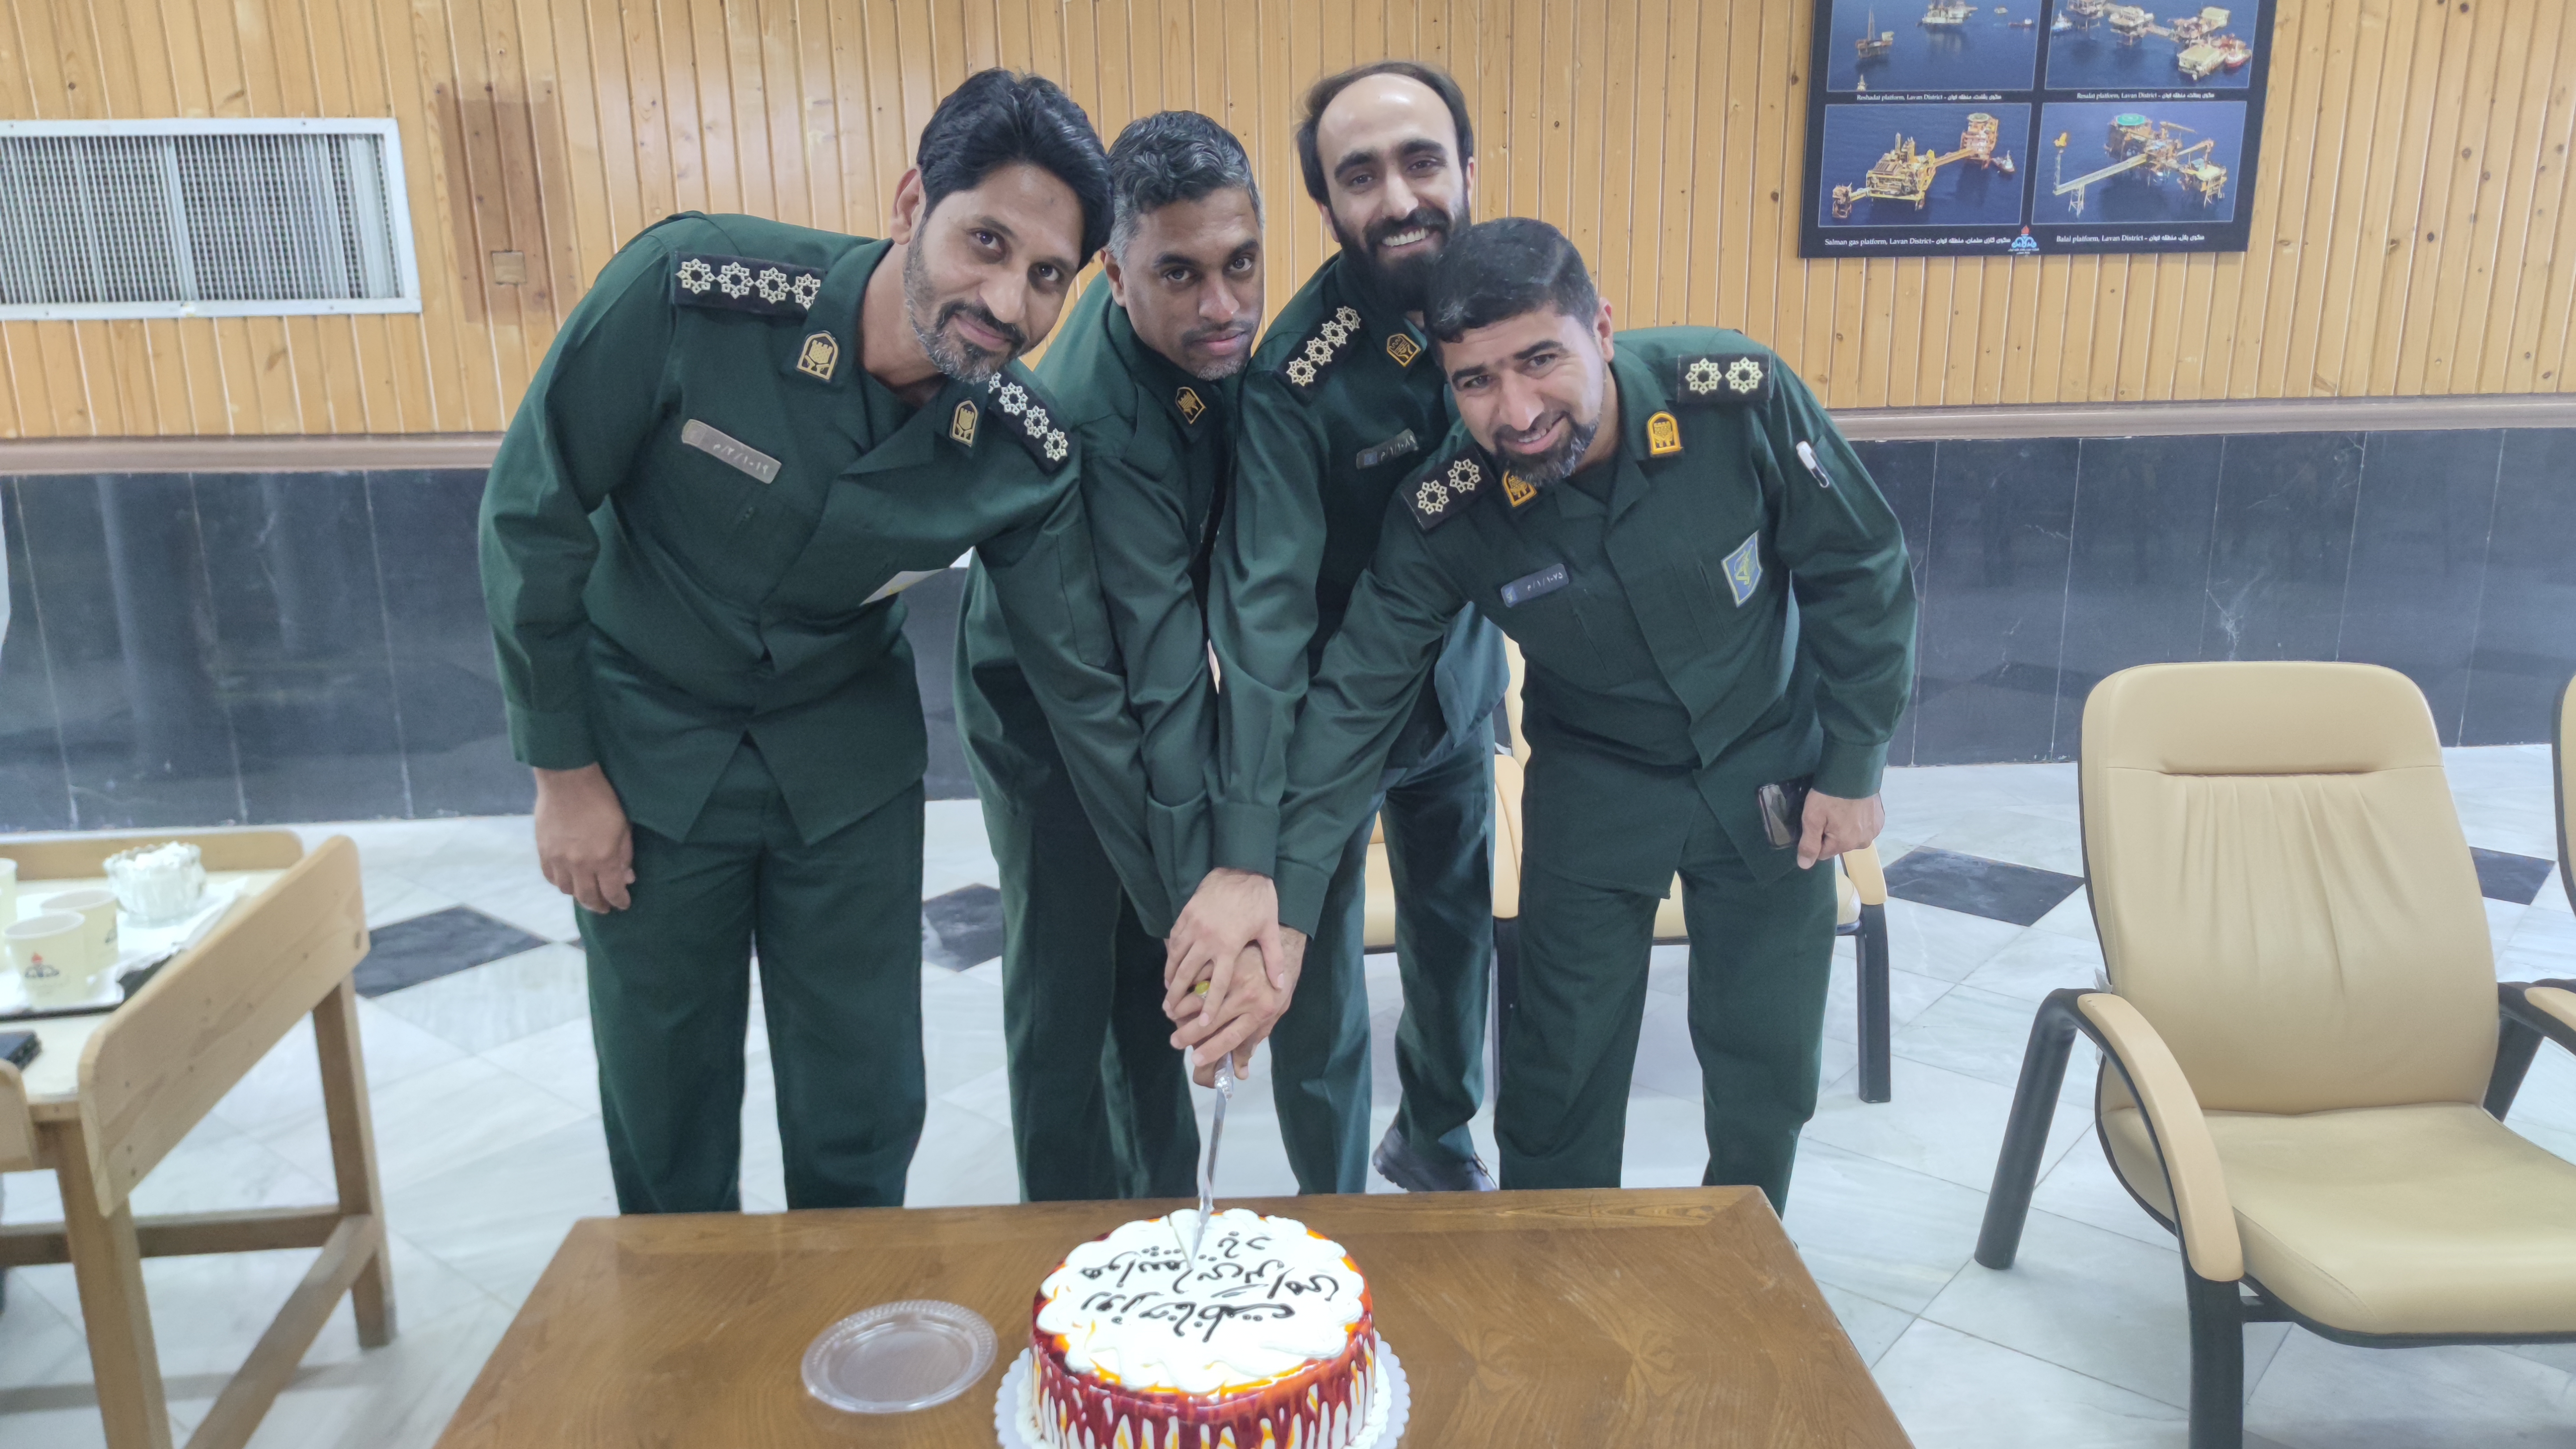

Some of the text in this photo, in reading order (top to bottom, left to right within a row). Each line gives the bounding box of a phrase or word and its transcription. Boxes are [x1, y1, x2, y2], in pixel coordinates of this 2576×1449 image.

[1881, 93, 1905, 102] platform,
[2096, 92, 2120, 101] platform,
[1860, 238, 1888, 246] platform,
[2072, 234, 2100, 244] platform,
[1217, 1231, 1275, 1258] باد
[1210, 1259, 1339, 1301] گرامی
[1080, 1291, 1296, 1342] روز حفاظت
